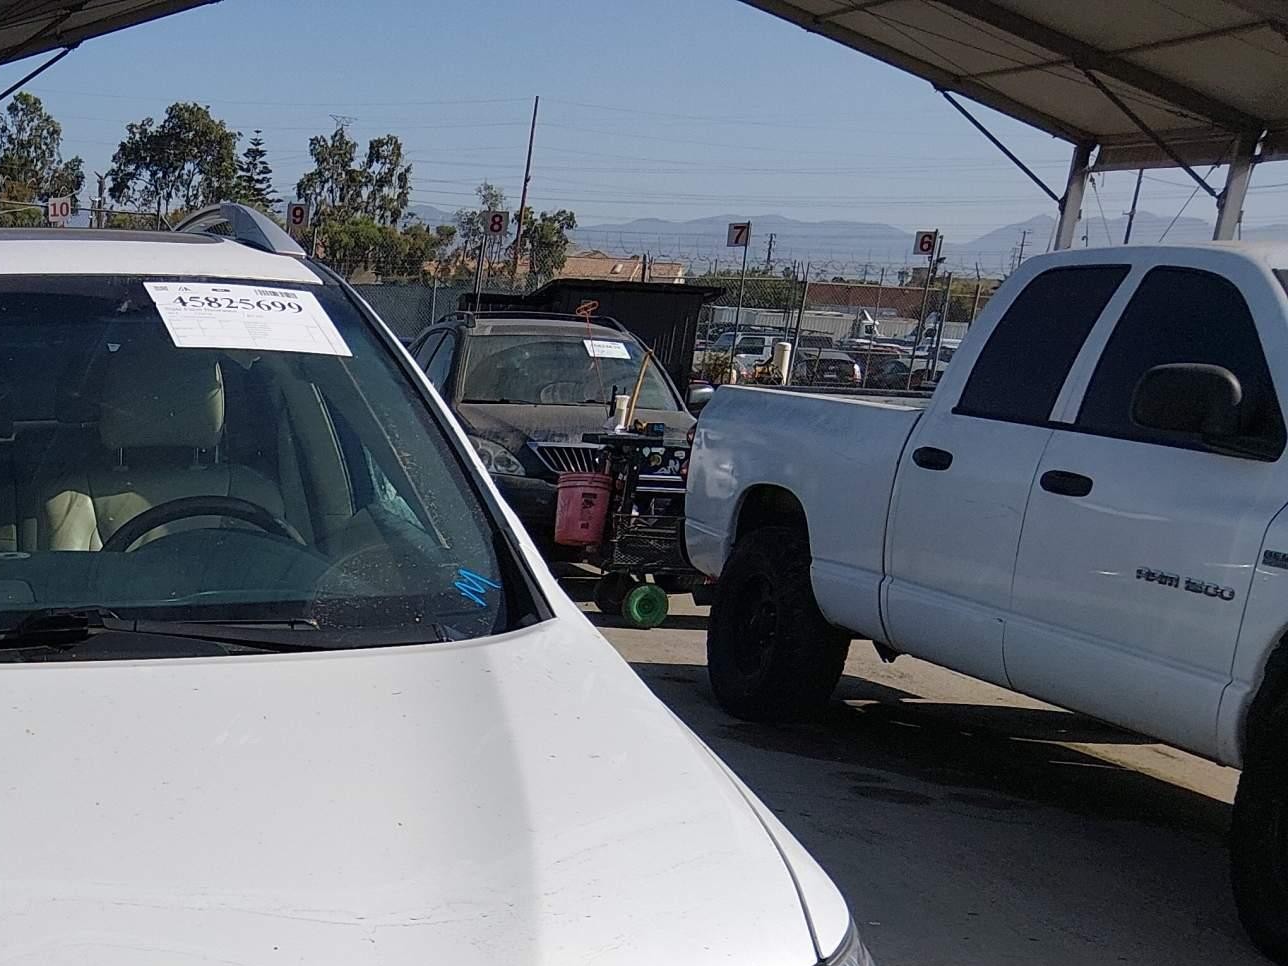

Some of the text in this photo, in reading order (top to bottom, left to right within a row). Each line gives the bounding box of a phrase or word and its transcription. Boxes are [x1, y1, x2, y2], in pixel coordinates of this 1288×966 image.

[50, 202, 69, 217] 10
[292, 206, 304, 225] 9
[489, 214, 502, 232] 8
[733, 226, 747, 245] 7
[919, 234, 933, 252] 6
[173, 295, 303, 314] 45825699
